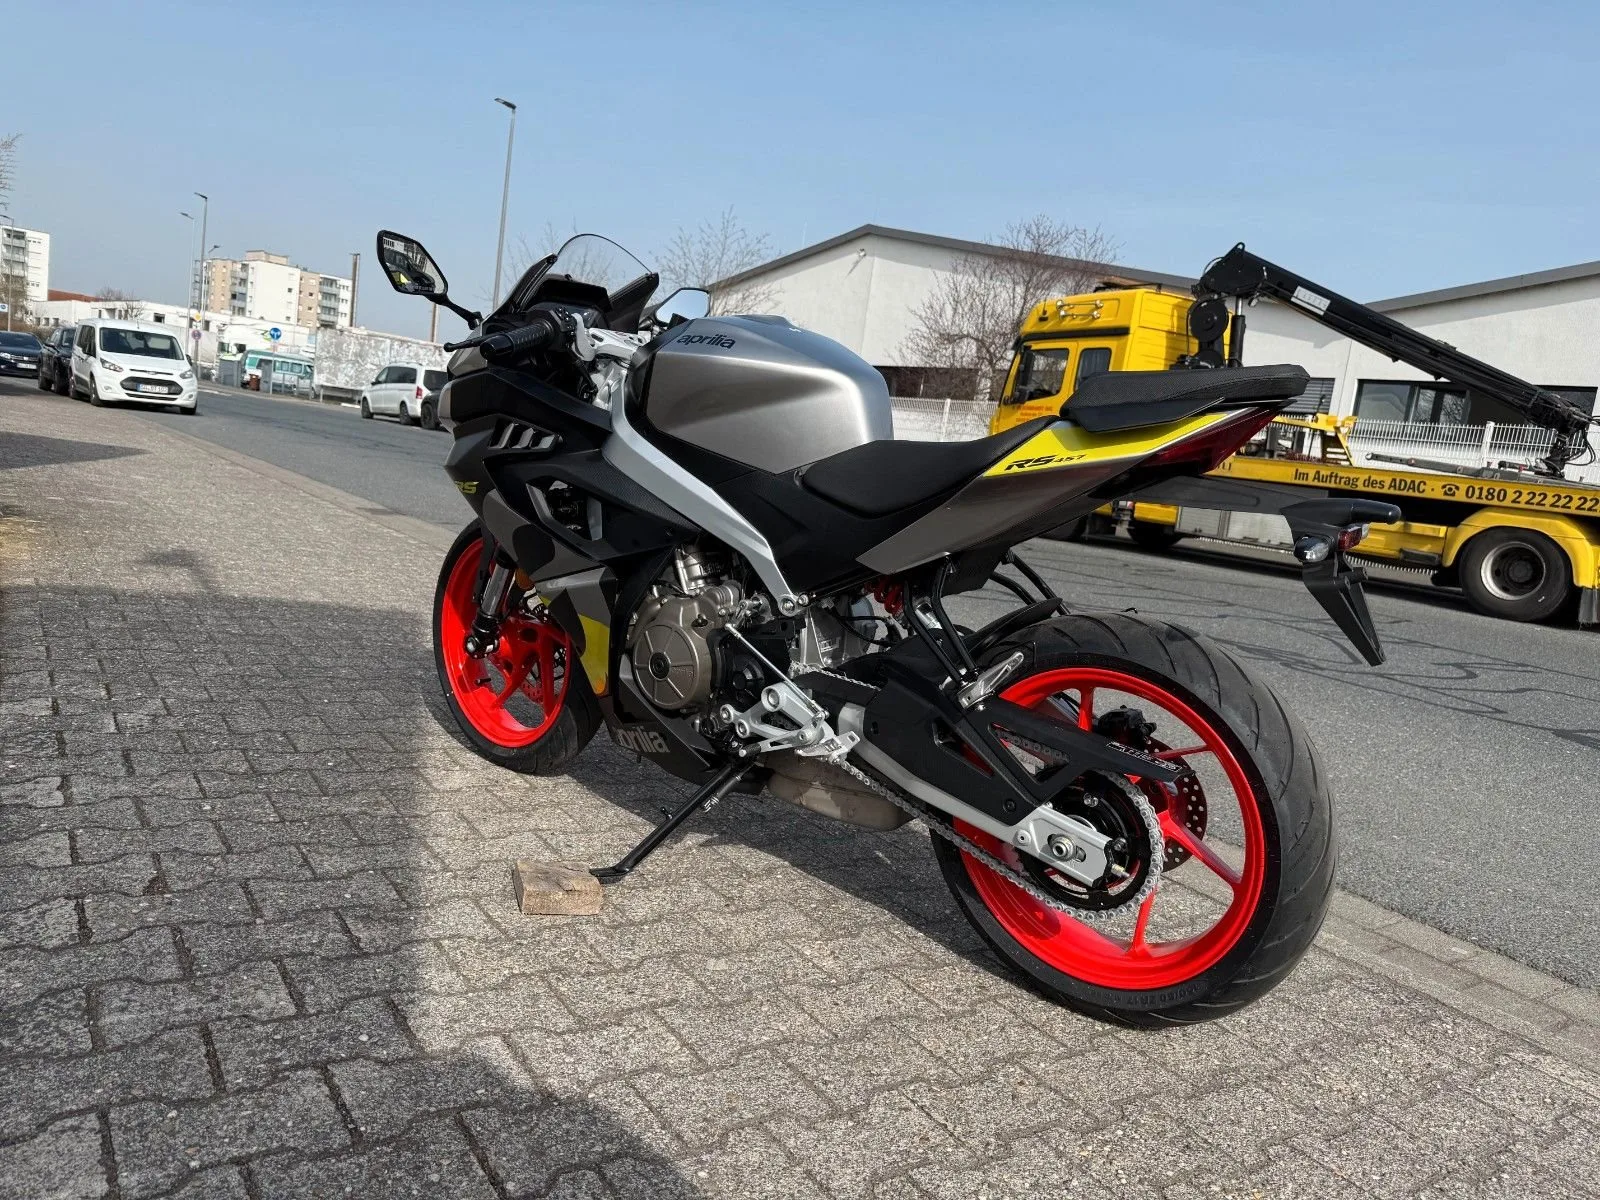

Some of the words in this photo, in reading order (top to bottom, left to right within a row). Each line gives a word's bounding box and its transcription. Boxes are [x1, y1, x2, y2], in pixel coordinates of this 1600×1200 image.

[677, 334, 736, 349] aprilia
[1294, 468, 1309, 481] Im
[1312, 470, 1360, 489] Auftrag
[1363, 475, 1385, 490] des
[1388, 478, 1427, 494] ADAC
[1465, 485, 1507, 503] 0180
[613, 726, 671, 753] prilia
